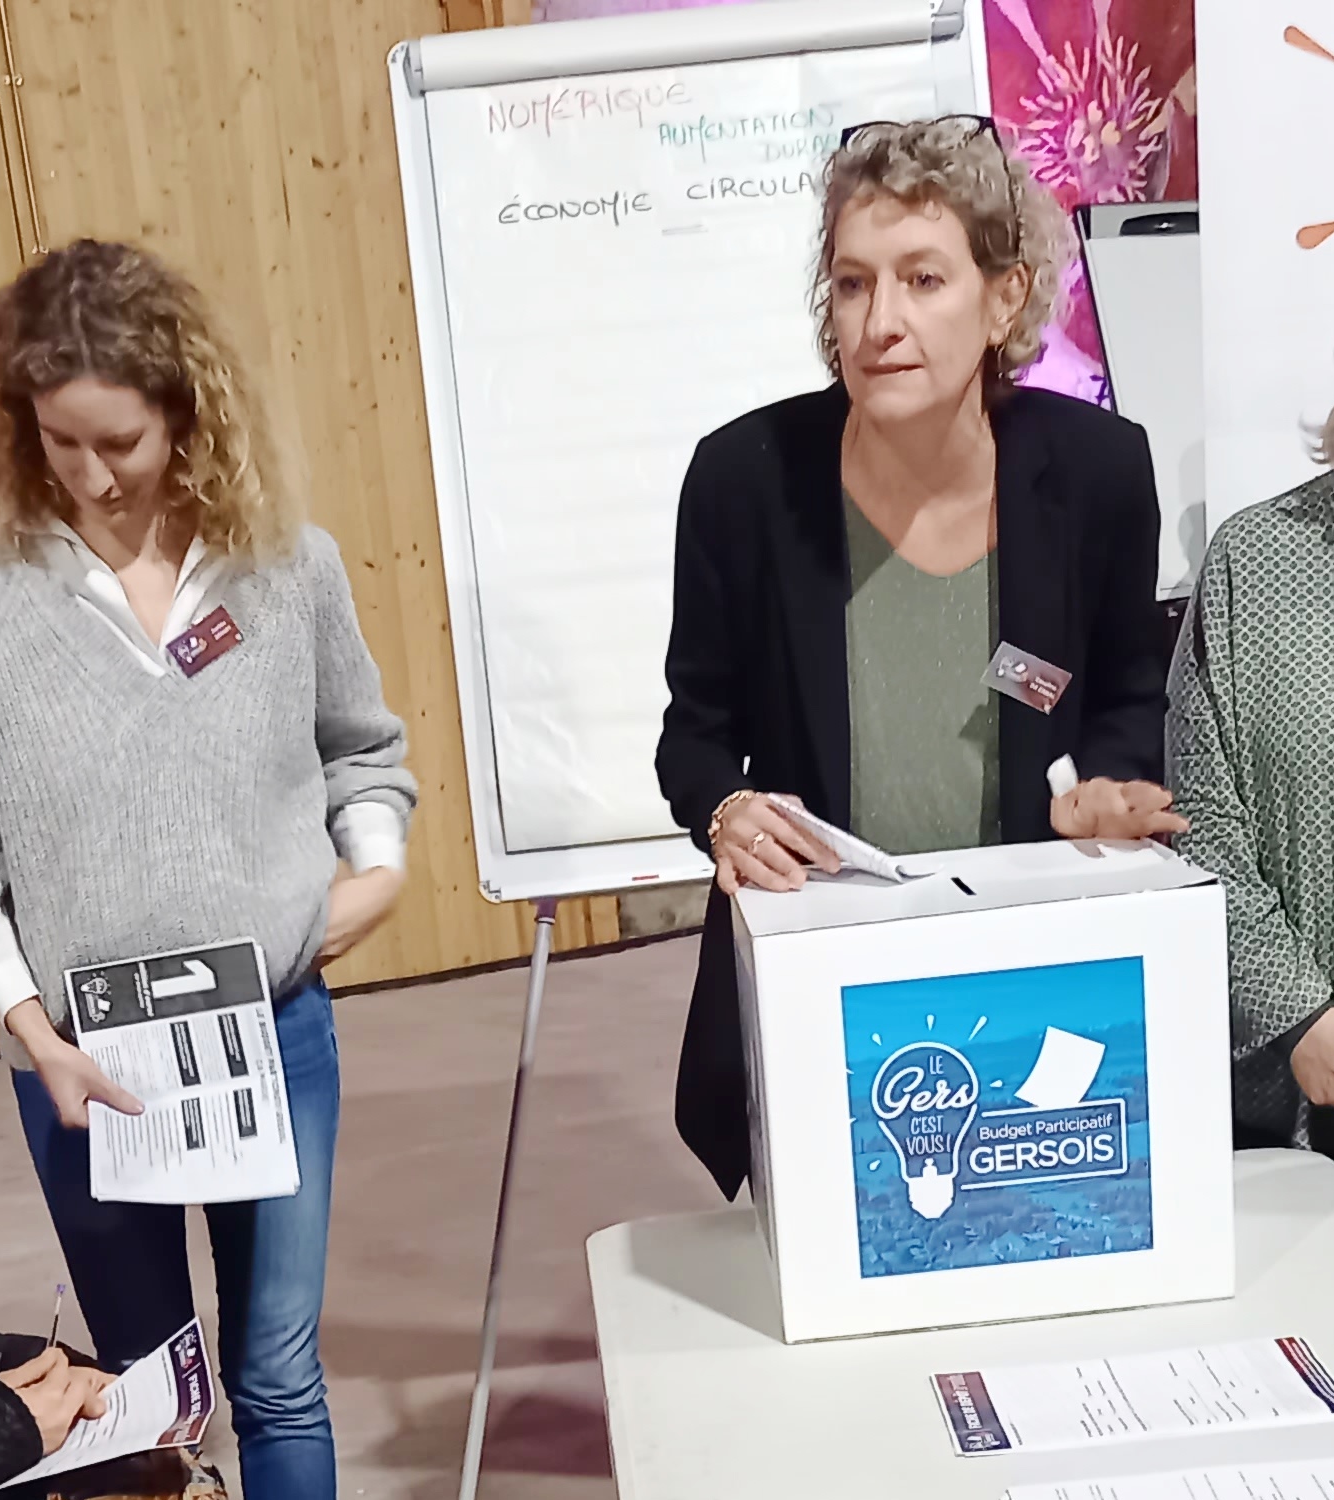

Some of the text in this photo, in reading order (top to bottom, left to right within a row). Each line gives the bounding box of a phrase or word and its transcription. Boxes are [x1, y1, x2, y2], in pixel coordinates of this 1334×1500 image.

[488, 82, 693, 138] NUMÉRIQUE
[498, 190, 652, 226] ÉCONOMIE
[929, 1055, 944, 1075] LE
[883, 1066, 970, 1120] Gers
[910, 1115, 944, 1135] C'EST
[979, 1112, 1113, 1141] Budget Participatif
[969, 1133, 1115, 1175] GERSOIS
